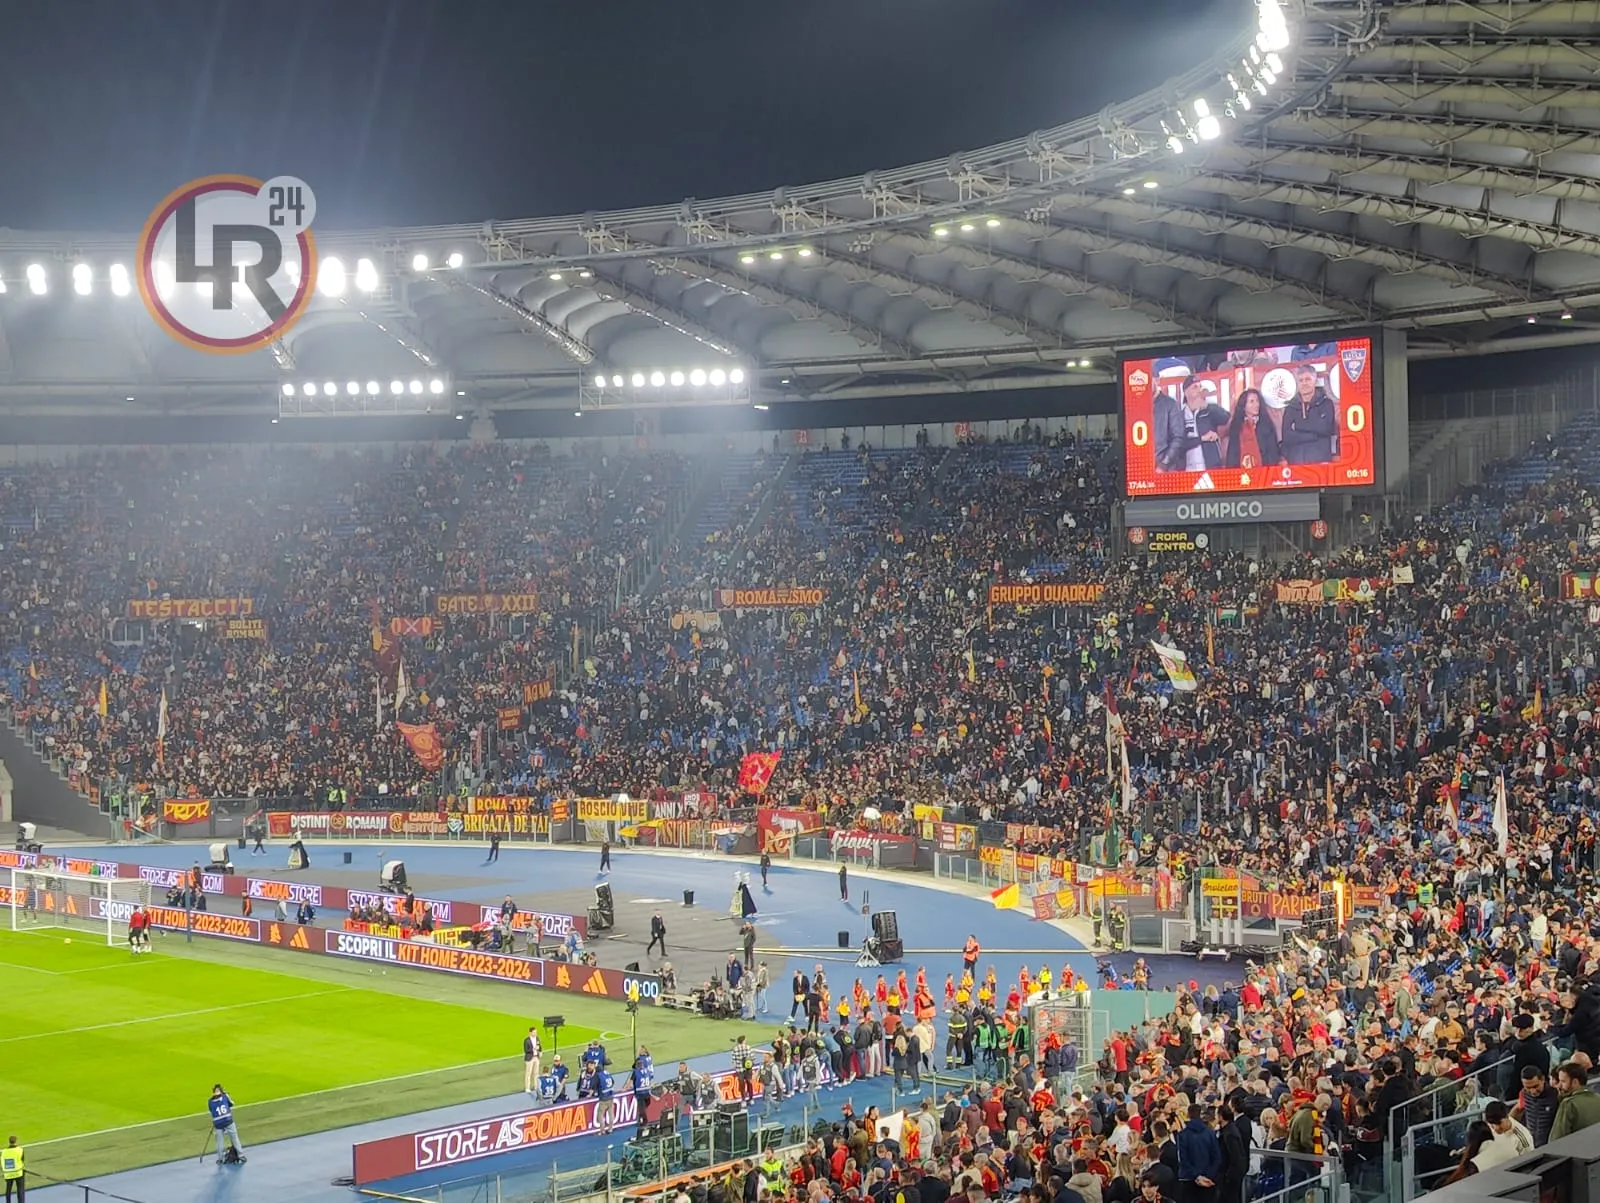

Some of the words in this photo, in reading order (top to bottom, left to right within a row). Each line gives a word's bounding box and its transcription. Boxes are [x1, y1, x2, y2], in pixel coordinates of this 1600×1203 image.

[1347, 405, 1364, 432] 0
[1132, 420, 1148, 446] 0
[1346, 468, 1369, 478] 00:16
[1176, 501, 1263, 520] OLIMPICO
[1156, 532, 1188, 541] ROMA
[1149, 542, 1195, 551] CENTRO
[991, 585, 1040, 602] GRUPPO
[437, 596, 477, 613] GATE
[501, 595, 536, 612] XXII
[580, 801, 617, 816] ROSCIO
[290, 815, 330, 829] DISTINTI
[346, 816, 388, 830] ROMANI
[463, 814, 509, 833] BRIGATA
[513, 814, 528, 833] DE
[250, 880, 319, 904] ASROMASTORE
[195, 914, 250, 937] 2023-2024
[337, 934, 383, 955] SCOPRI
[384, 941, 396, 959] IL
[397, 943, 418, 965] KIT
[421, 948, 458, 973] HOME
[460, 952, 531, 980] 2023-2024
[623, 978, 659, 999] 00:00
[215, 1104, 228, 1116] 16
